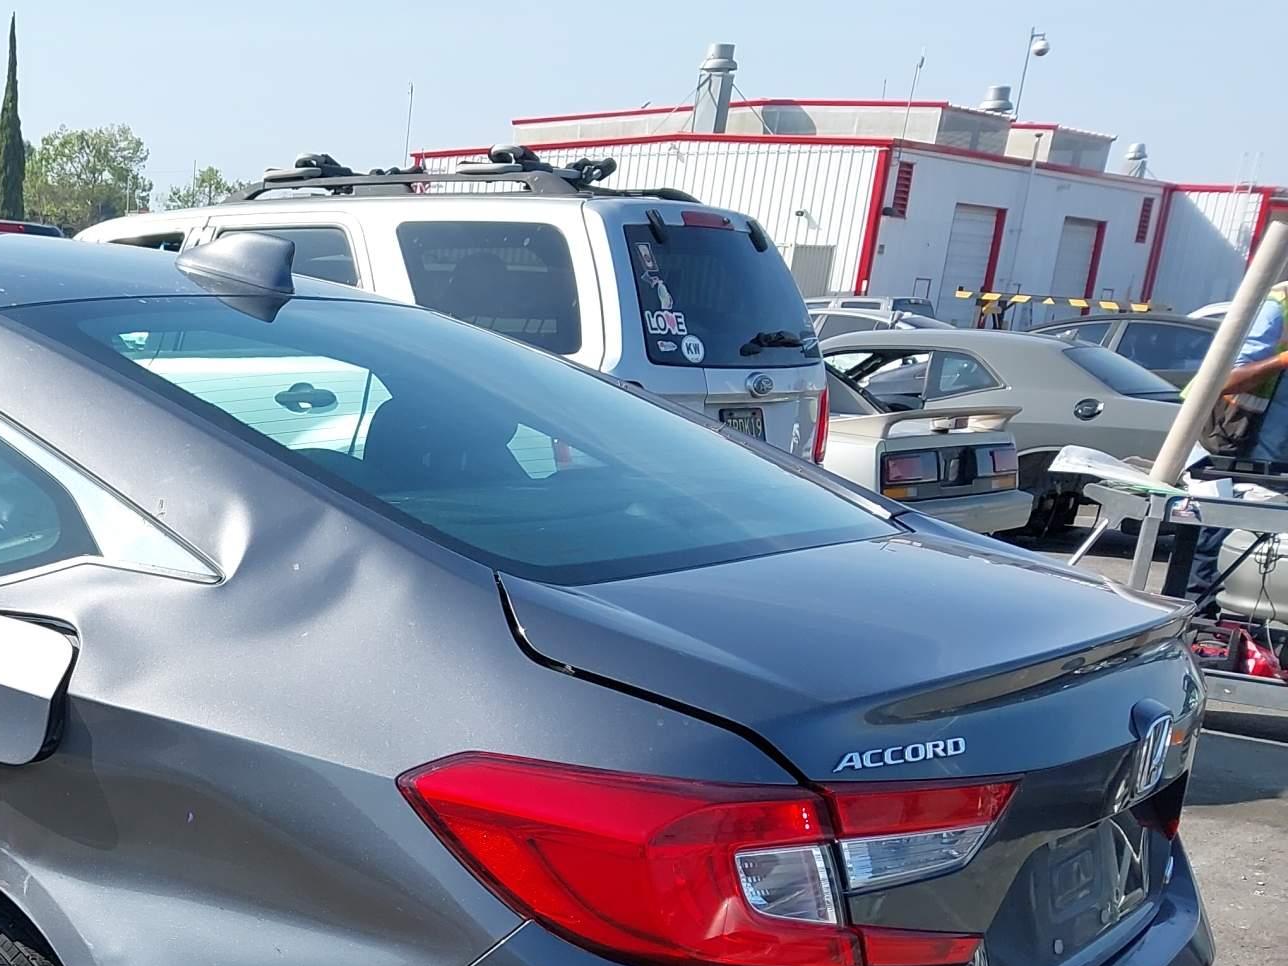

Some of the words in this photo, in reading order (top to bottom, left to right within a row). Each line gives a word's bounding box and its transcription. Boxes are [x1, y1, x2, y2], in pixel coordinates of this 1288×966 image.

[645, 311, 687, 335] LOVE
[685, 343, 701, 355] KW
[832, 737, 967, 773] ACCORD
